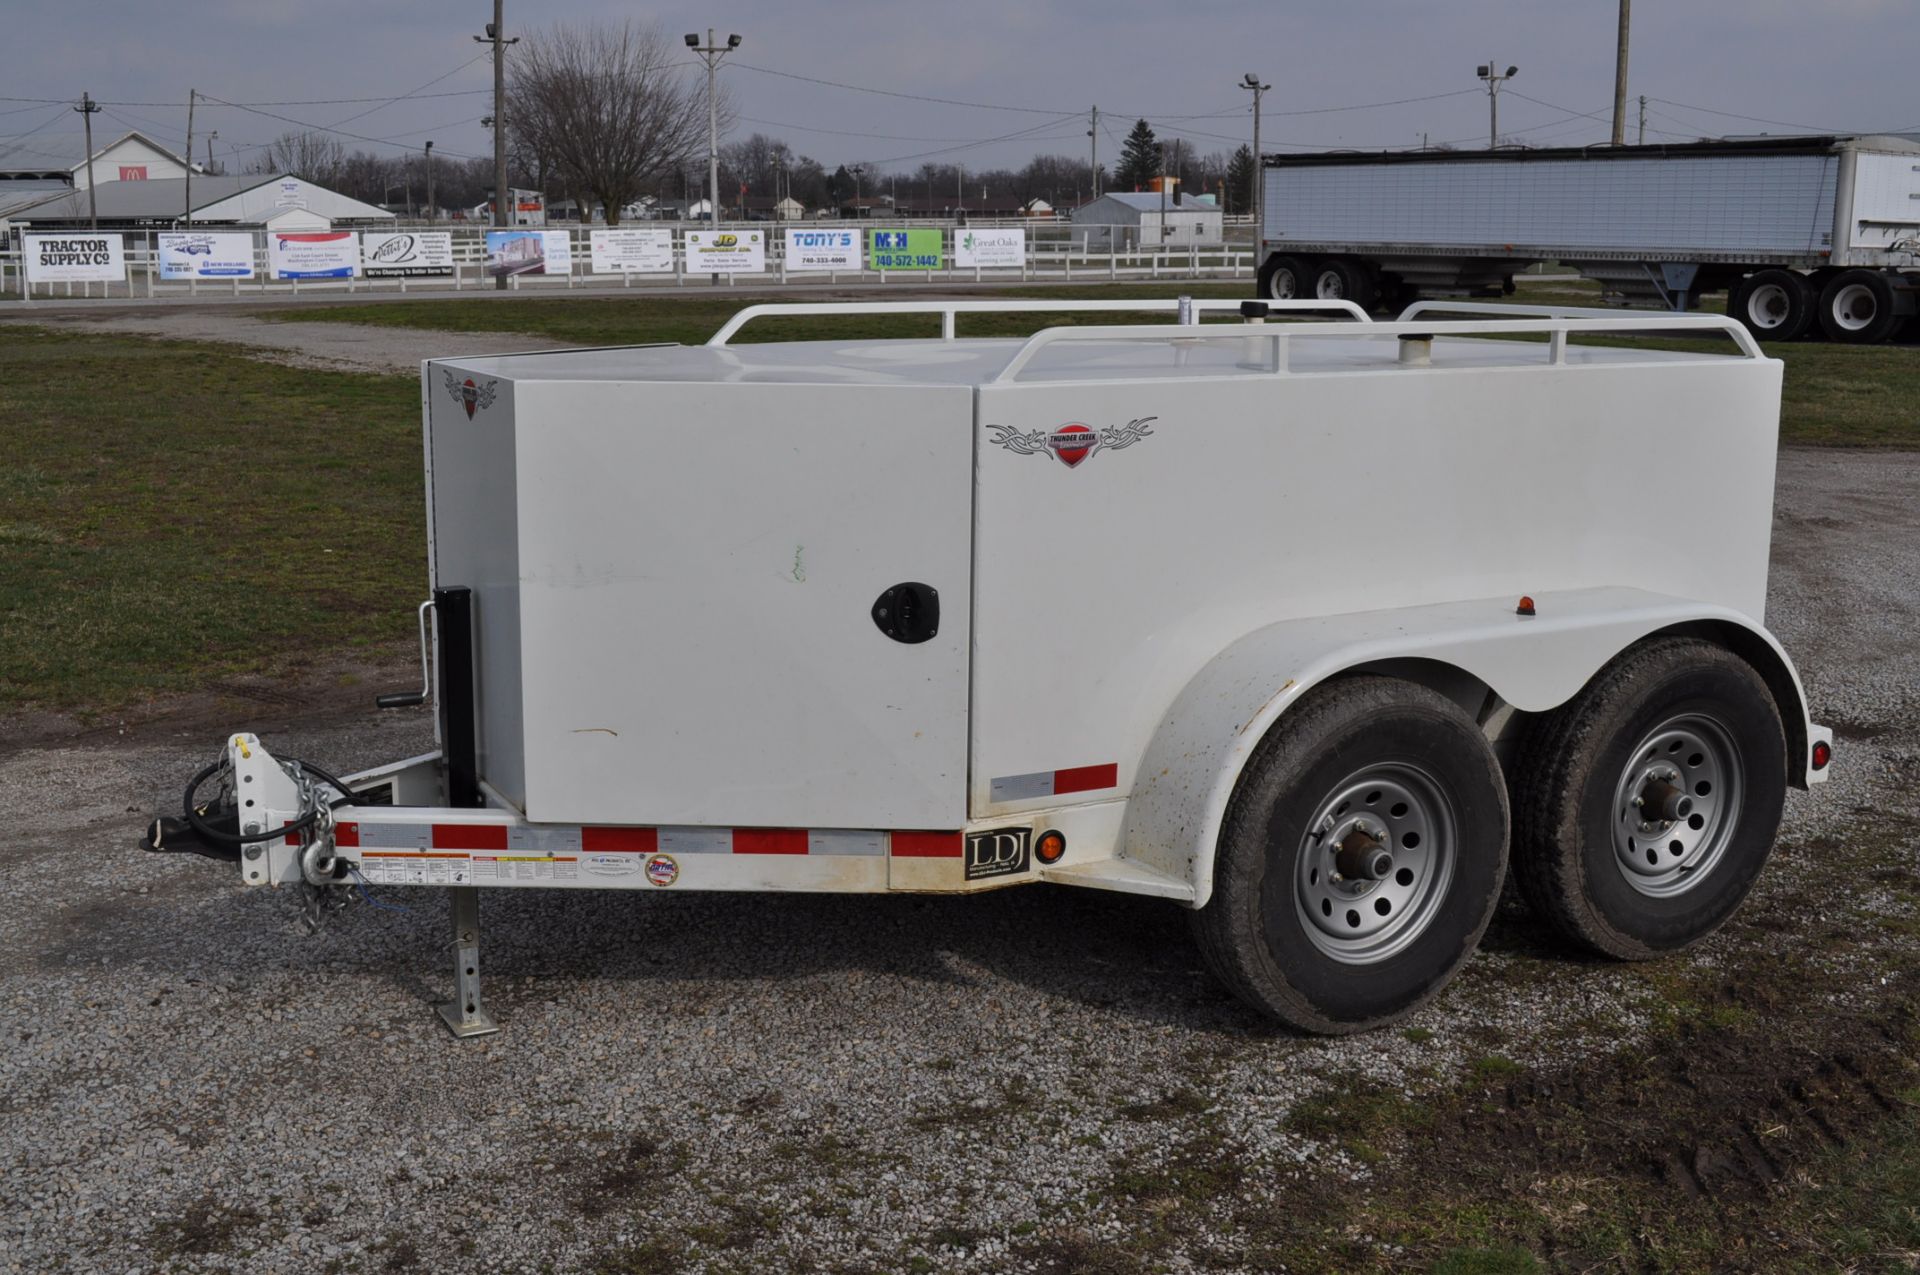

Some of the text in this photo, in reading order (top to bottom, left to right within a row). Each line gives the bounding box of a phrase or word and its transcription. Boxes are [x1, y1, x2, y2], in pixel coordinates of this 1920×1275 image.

[39, 239, 109, 253] TRACTOR
[712, 234, 738, 247] JD
[793, 233, 852, 246] TONY'S
[973, 238, 1018, 247] Great Oaks
[40, 253, 92, 266] SUPPLY
[875, 255, 938, 266] 740-572-1442
[1050, 433, 1096, 443] THUNDER CREEK
[970, 832, 1028, 870] LDJ
